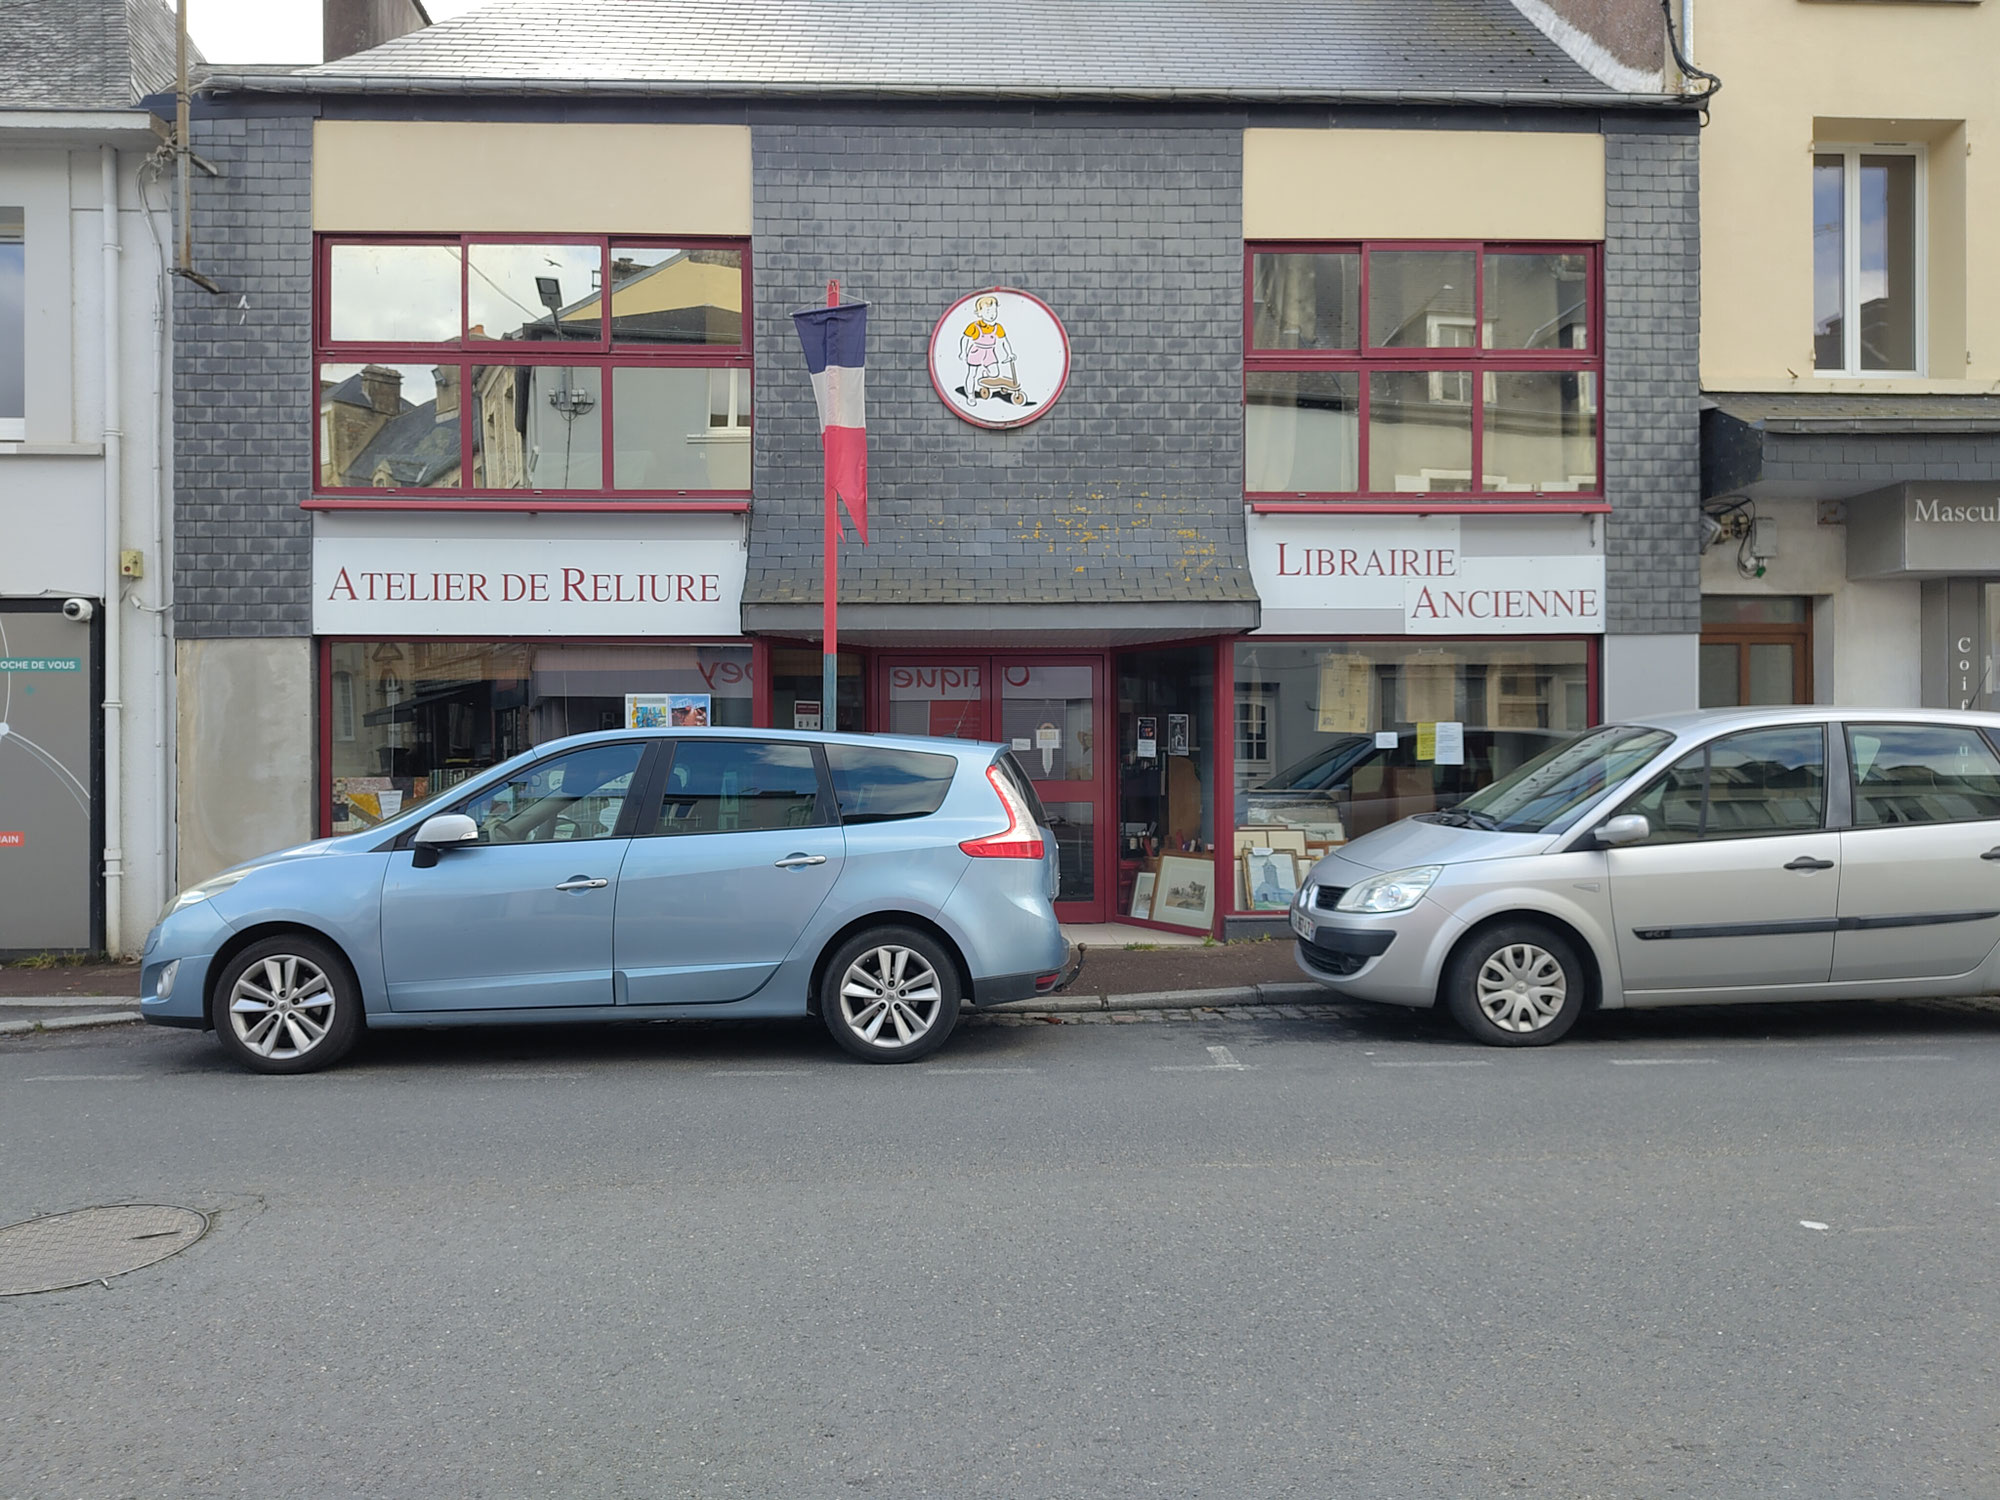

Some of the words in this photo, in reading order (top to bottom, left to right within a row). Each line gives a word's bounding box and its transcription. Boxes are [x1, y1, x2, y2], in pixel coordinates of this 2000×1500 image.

[1276, 543, 1456, 577] LIBRAIRIE
[328, 566, 490, 602] ATELIER
[501, 573, 550, 602] DE
[560, 567, 721, 602] RELIURE
[1410, 585, 1598, 619] ANCIENNE
[31, 660, 46, 670] DE
[47, 660, 76, 670] VOUS
